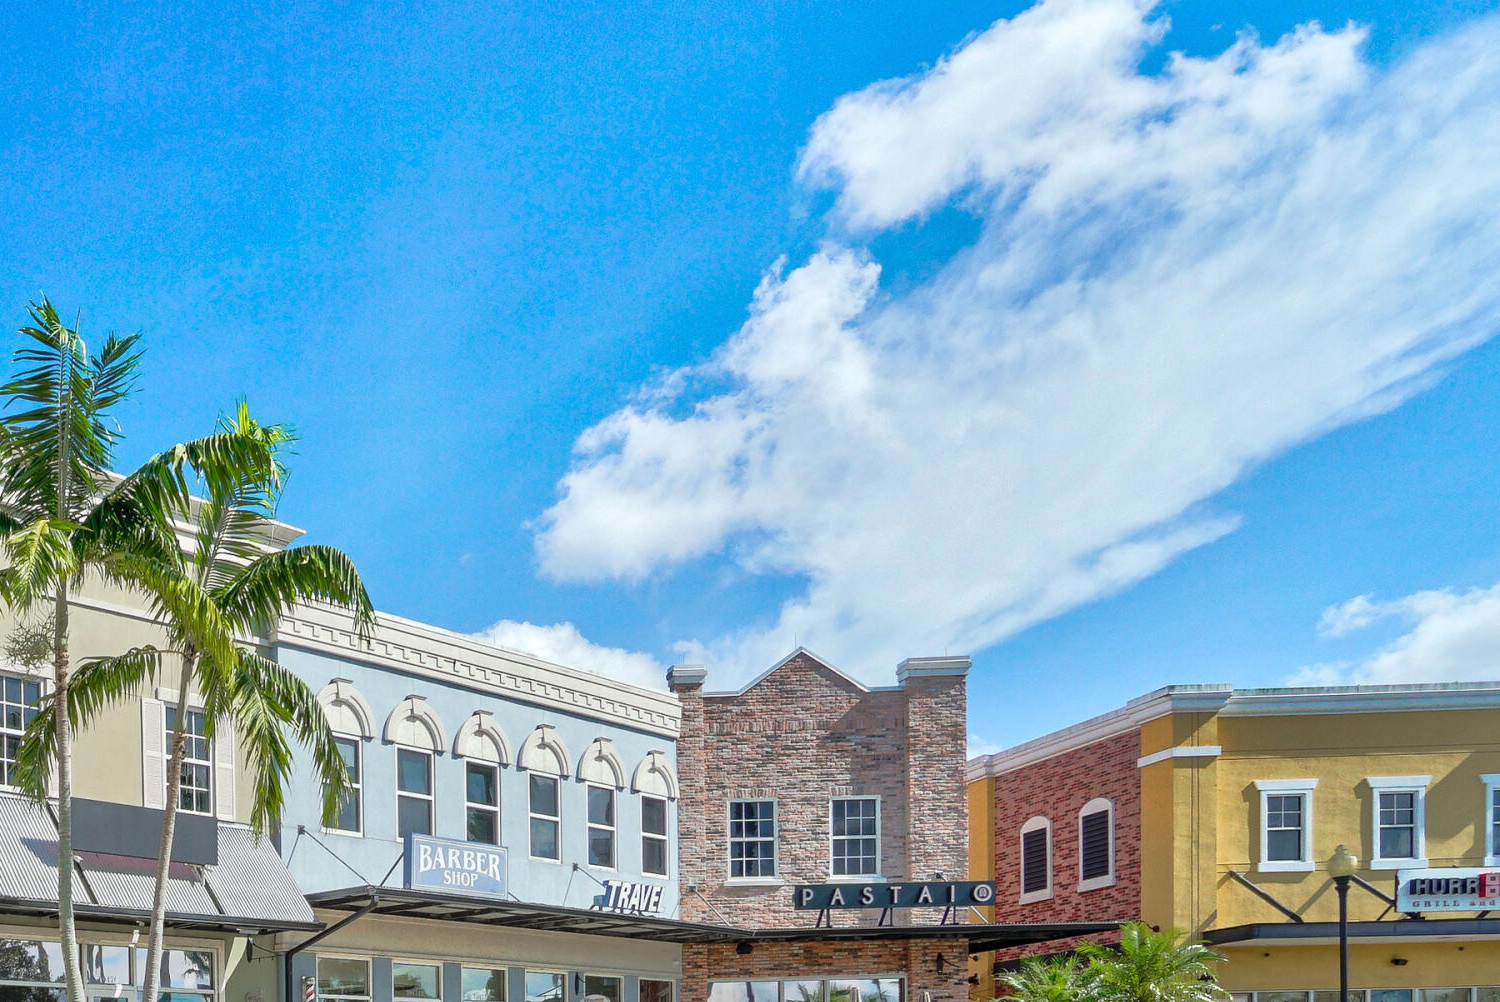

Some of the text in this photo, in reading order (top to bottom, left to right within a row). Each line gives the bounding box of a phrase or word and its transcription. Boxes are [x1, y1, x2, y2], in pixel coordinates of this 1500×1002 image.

[419, 844, 502, 882] BARBER
[443, 870, 478, 888] SHOP
[606, 879, 667, 913] TRAVEL
[802, 884, 993, 907] PASTAIO
[1412, 899, 1496, 908] GRILL and
